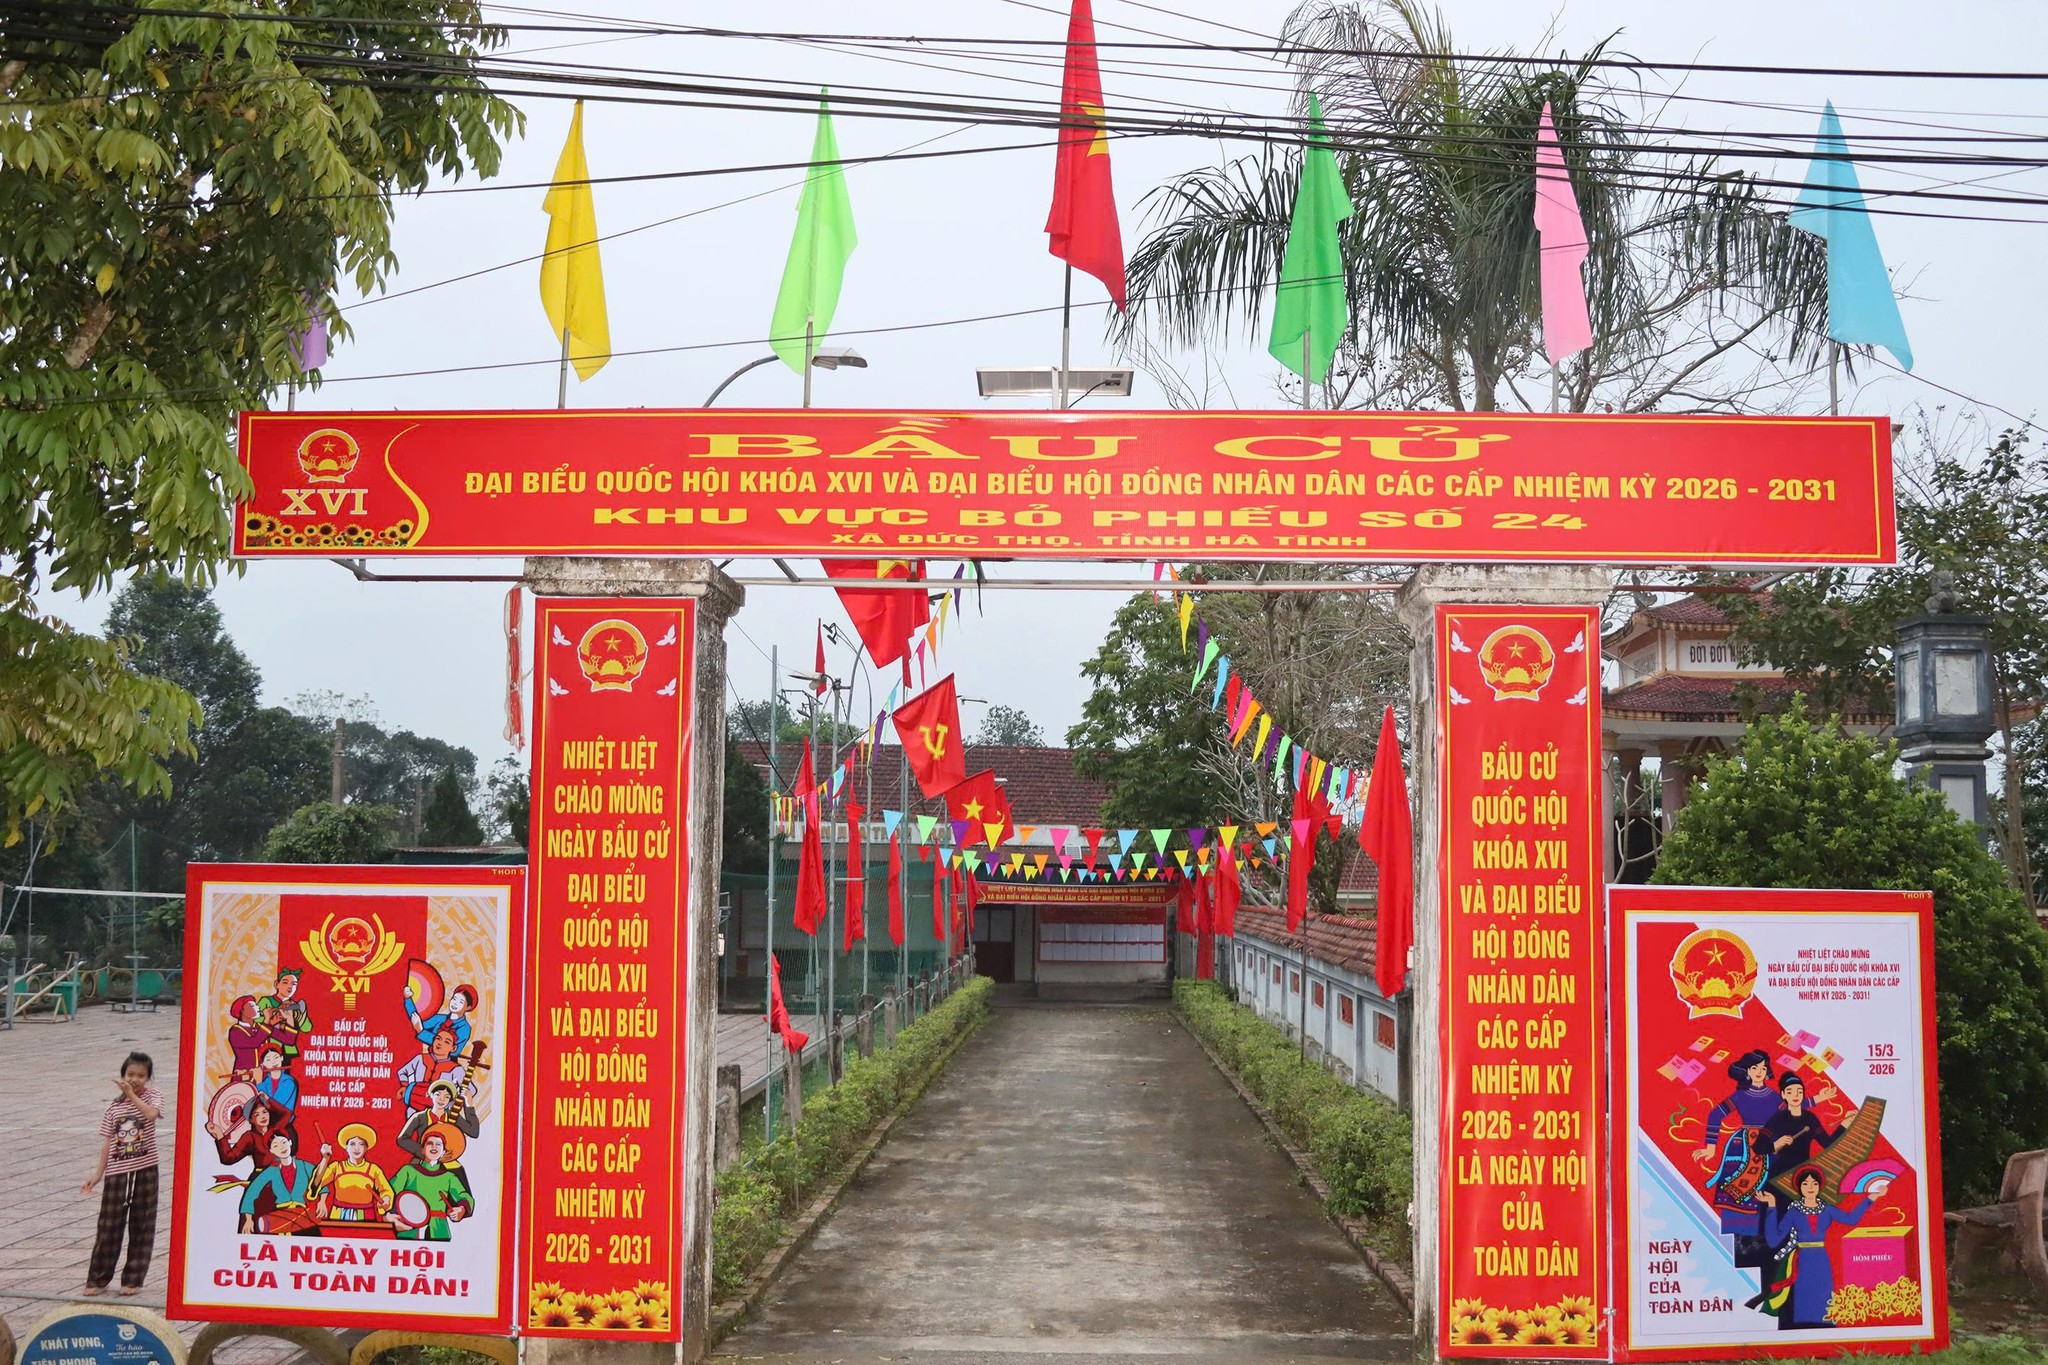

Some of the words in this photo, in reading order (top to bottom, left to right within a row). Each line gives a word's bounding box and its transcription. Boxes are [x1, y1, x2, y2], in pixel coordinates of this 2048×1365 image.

[689, 419, 1138, 460] BẦU
[1214, 426, 1511, 462] CỬ
[465, 473, 512, 497] ĐẠI
[523, 463, 586, 493] BIỂU
[597, 464, 672, 494] QUỐC
[683, 467, 729, 496] HỘI
[740, 467, 816, 492] KHÓA
[827, 472, 872, 493] XVI
[883, 467, 919, 493] VÀ
[928, 472, 976, 498] ĐẠI
[988, 464, 1053, 495] BIỂU
[1064, 469, 1111, 500] HỘI
[1121, 466, 1202, 497] ĐỒNG
[1213, 469, 1295, 495] NHÂN
[1306, 469, 1365, 495] DÂN
[1376, 470, 1434, 496] CÁC
[1445, 468, 1503, 496] CẤP
[1514, 472, 1609, 502] NHIỆM
[1620, 473, 1656, 498] KỲ
[1667, 478, 1737, 499] 2026
[1769, 479, 1834, 500] 2031
[280, 489, 368, 515] XVI
[594, 508, 747, 524] KHU
[776, 507, 928, 528] VỰC
[960, 504, 1062, 526] BỎ
[1093, 505, 1327, 527] PHIẾU
[1359, 507, 1465, 528] SỐ
[1492, 513, 1587, 529] 24
[831, 533, 884, 543] XÃ
[898, 532, 979, 544] ĐỨC
[994, 536, 1082, 547] THỌ,
[1097, 532, 1187, 546] TỈNH
[1205, 534, 1259, 545] HÀ
[1273, 535, 1366, 546] TĨNH
[563, 735, 615, 775] NHIỆT
[621, 735, 657, 776] LIỆT
[1482, 742, 1522, 780] BẦU
[1530, 742, 1558, 780] CỬ
[555, 780, 602, 813] CHÀO
[609, 780, 663, 814] MỪNG
[1472, 786, 1526, 827] QUỐC
[1534, 790, 1567, 830] HỘI
[548, 824, 596, 857] NGÀY
[602, 820, 638, 858] BẦU
[645, 820, 670, 858] CỬ
[1473, 834, 1528, 869] KHÓA
[1535, 841, 1566, 868] XVI
[568, 873, 598, 908] ĐẠI
[605, 863, 645, 903] BIỂU
[1460, 879, 1486, 913] VÀ
[1493, 885, 1526, 920] ĐẠI
[1535, 873, 1580, 914] BIỂU
[564, 908, 611, 950] QUỐC
[618, 913, 648, 954] HỘI
[1473, 924, 1506, 965] HỘI
[1513, 920, 1569, 958] ĐỒNG
[1768, 962, 1785, 972] NGÀY
[1812, 964, 1822, 974] ĐẠI
[1840, 961, 1857, 973] QUỐC
[1859, 962, 1869, 974] HỘI
[1890, 964, 1900, 972] XVI
[1798, 948, 1816, 960] NHIỆT
[1818, 948, 1830, 960] LIỆT
[1832, 948, 1849, 958] CHÀO
[331, 977, 370, 992] XVI
[563, 957, 611, 992] KHÓA
[618, 964, 646, 992] XVI
[1468, 969, 1525, 1003] NHÂN
[1533, 969, 1575, 1003] DÂN
[1799, 990, 1819, 1002] NHIỆM
[1821, 990, 1829, 1000] KỲ
[1831, 991, 1846, 1000] 2026
[551, 1002, 573, 1036] VÀ
[580, 1008, 609, 1043] ĐẠI
[617, 997, 657, 1037] BIỂU
[1478, 1014, 1518, 1048] CÁC
[1526, 1010, 1566, 1048] CẤP
[311, 1036, 325, 1048] ĐẠI
[349, 1033, 371, 1048] QUỐC
[373, 1035, 388, 1050] HỘI
[329, 1051, 342, 1061] XVI
[345, 1049, 355, 1062] VÀ
[358, 1052, 371, 1065] ĐẠI
[1869, 1044, 1893, 1056] 15/3
[306, 1063, 319, 1078] HỘI
[347, 1065, 370, 1078] NHÂN
[373, 1065, 390, 1078] DÂN
[561, 1047, 590, 1088] HỘI
[597, 1044, 646, 1082] ĐỒNG
[1472, 1059, 1539, 1100] NHIỆM
[1547, 1059, 1572, 1093] KỲ
[1870, 1064, 1894, 1074] 2026
[301, 1094, 328, 1108] NHIỆM
[330, 1095, 342, 1107] KỲ
[344, 1097, 364, 1108] 2026
[372, 1098, 391, 1109] 2031
[329, 1079, 346, 1092] CÁC
[348, 1078, 365, 1092] CẤP
[555, 1092, 606, 1126] NHÂN
[613, 1093, 650, 1127] DÂN
[1462, 1110, 1511, 1139] 2026
[1533, 1111, 1579, 1139] 2031
[562, 1137, 597, 1172] CÁC
[605, 1134, 640, 1172] CẤP
[1459, 1149, 1483, 1184] LÀ
[1490, 1150, 1545, 1184] NGÀY
[1553, 1150, 1586, 1191] HỘI
[556, 1183, 615, 1224] NHIỆM
[622, 1184, 645, 1218] KỲ
[1503, 1191, 1544, 1230] CỦA
[241, 1241, 278, 1261] LÀ
[290, 1244, 378, 1265] NGÀY
[391, 1247, 444, 1271] HỘI
[546, 1234, 589, 1263] 2026
[609, 1235, 650, 1264] 2031
[1474, 1241, 1528, 1276] TOÀN
[1536, 1241, 1578, 1276] DÂN
[1649, 1238, 1691, 1254] NGÀY
[214, 1263, 278, 1288] CỦA
[290, 1271, 375, 1292] TOÀN
[389, 1274, 468, 1296] DÂN!
[1648, 1259, 1677, 1276] HỘI
[1650, 1278, 1681, 1294] CỦA
[1649, 1298, 1693, 1313] TOÀN
[1700, 1297, 1732, 1312] DÂN
